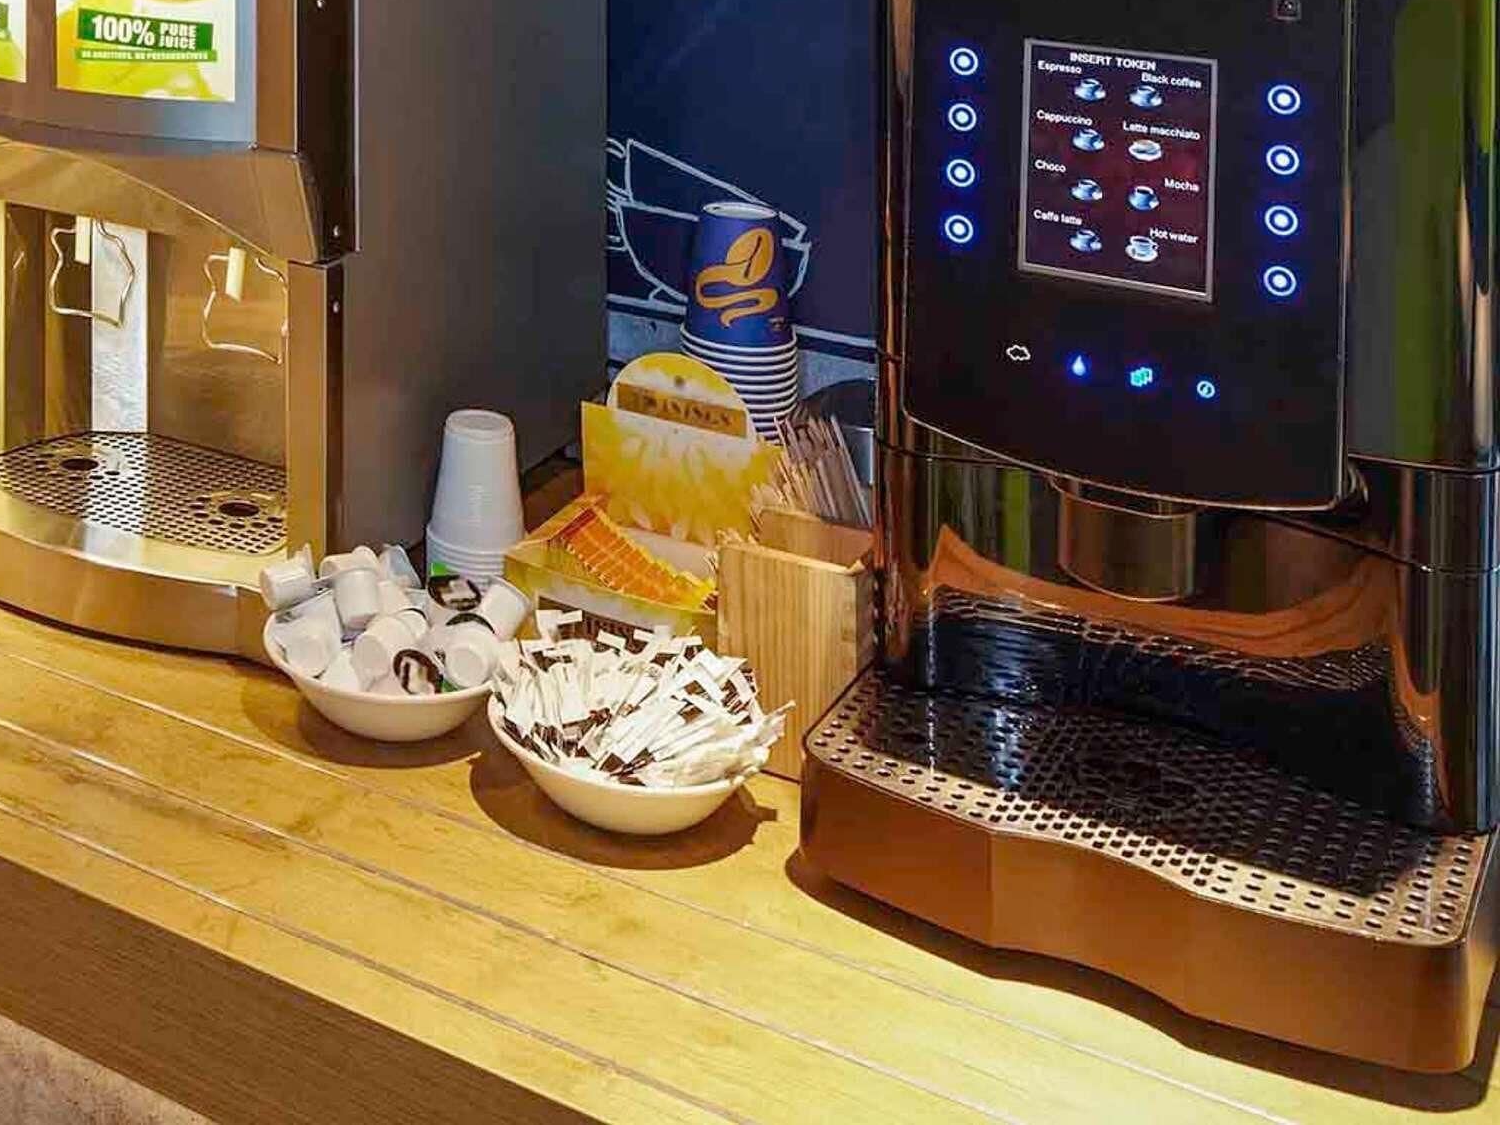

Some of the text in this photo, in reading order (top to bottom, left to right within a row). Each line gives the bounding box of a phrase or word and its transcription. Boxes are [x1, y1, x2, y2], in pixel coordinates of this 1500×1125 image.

[92, 14, 197, 47] 100% PURE
[158, 35, 197, 50] JUICE
[1038, 60, 1082, 75] Espresso
[1070, 52, 1157, 71] INSERT TOKEN
[1141, 72, 1202, 89] Black coffee
[1036, 109, 1093, 126] Cappuccino
[1123, 120, 1201, 141] Latte macchiato
[1034, 159, 1066, 173] Choco
[1164, 177, 1200, 193] Mocha
[1150, 227, 1199, 245] Hot water
